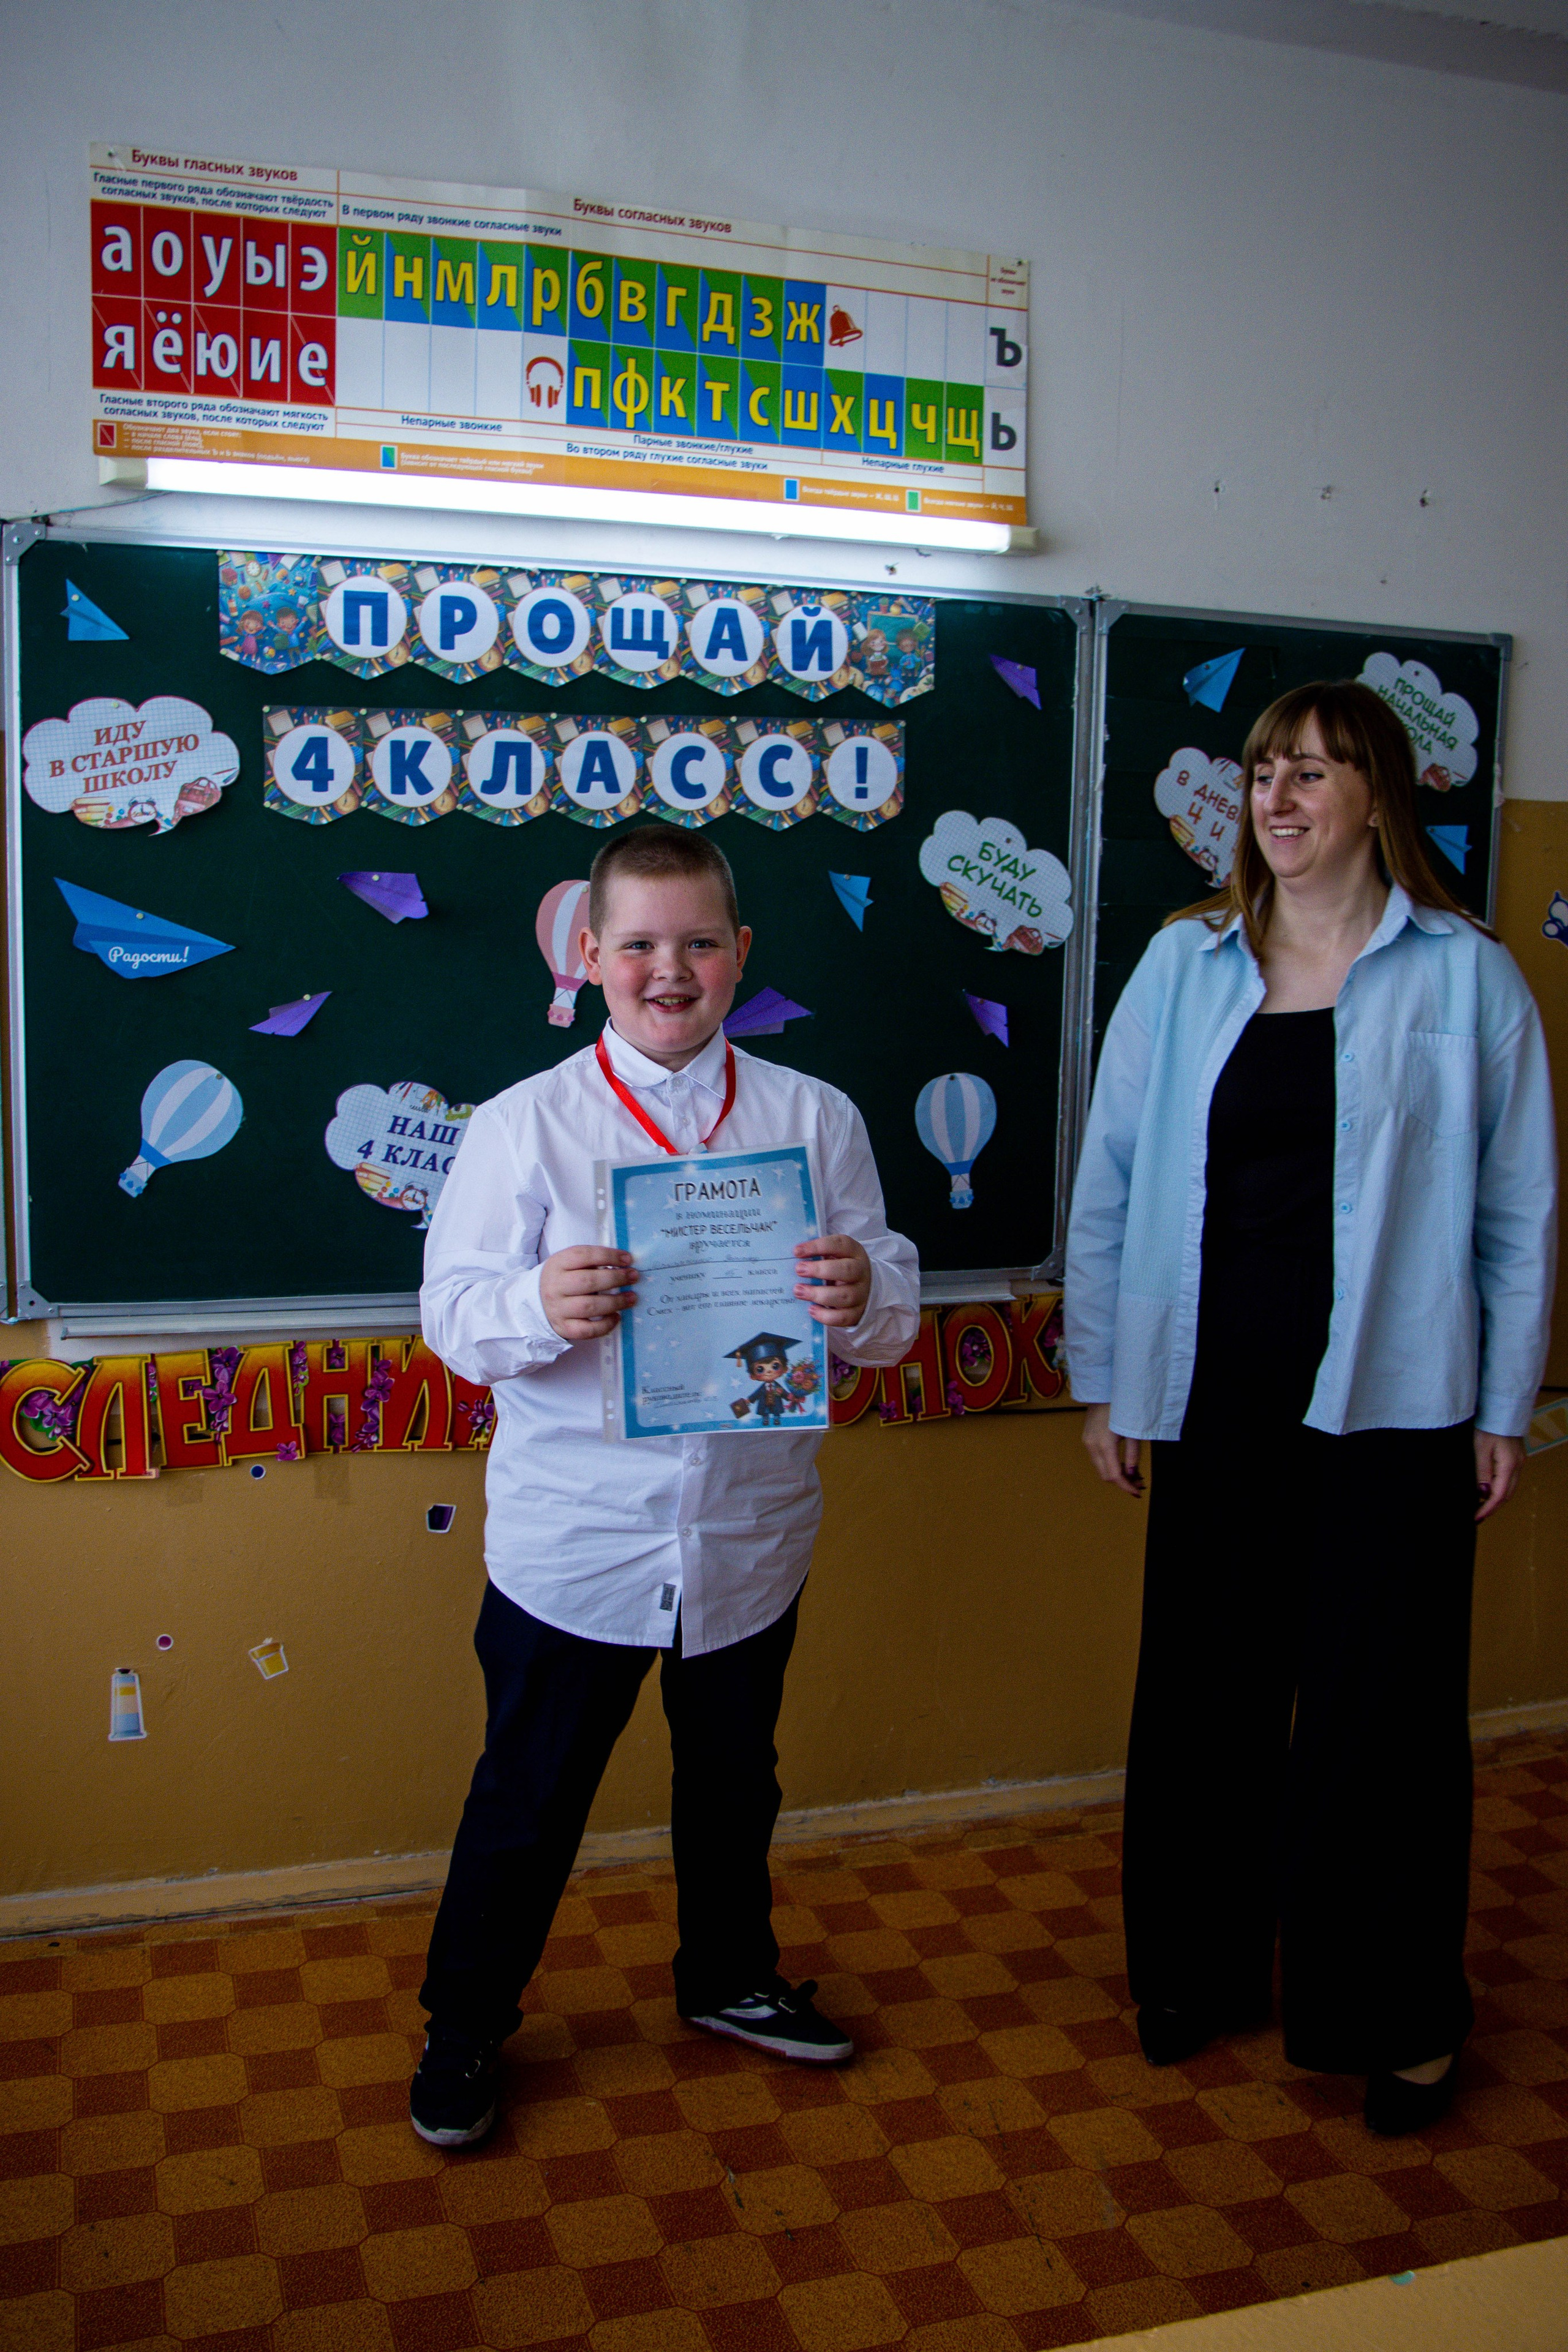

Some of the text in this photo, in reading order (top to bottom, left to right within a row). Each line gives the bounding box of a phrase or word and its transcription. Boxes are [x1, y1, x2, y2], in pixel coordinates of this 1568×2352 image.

[131, 149, 298, 182] Буквы гласных звуков
[92, 172, 334, 209] Гласные первого ряда обозначают твёрдость
[101, 185, 327, 219] согласных звуков, после которых следуют
[342, 204, 563, 237] В первом ряду звонкие согласные звуки
[573, 197, 732, 233] Буквы согласных звуков
[102, 226, 132, 271] а
[246, 241, 286, 287] ы
[103, 325, 134, 369] я
[153, 311, 183, 373] ё
[196, 333, 239, 378] ю
[298, 343, 328, 386] е
[100, 394, 328, 423] Гласные второго ряда обозначают мягкость
[104, 405, 325, 432] согласных звуков, после которых следуют
[401, 415, 503, 432] Непарные звонкие
[567, 443, 767, 472] Во втором ряду глухие согласные звуки
[633, 434, 753, 455] Парные звонкие/глухие
[862, 456, 944, 474] Непарные глухие
[343, 590, 834, 672] ПРОЩАЙ
[1378, 684, 1458, 751] НАЧАЛЬНАЯ
[1394, 677, 1456, 728] ПРОЩАЙ
[94, 720, 146, 746] ИДУ
[1404, 724, 1433, 755] ОЛА
[50, 734, 200, 778] В СТАРШУЮ
[291, 736, 869, 800] 4 КЛАСС!
[83, 760, 178, 794] ШКОЛУ
[1176, 769, 1242, 824] В ДНЕВ
[978, 841, 1037, 881] БУДУ
[947, 855, 1042, 918] СКУЧАТЬ
[108, 946, 190, 969] Радости!
[387, 1115, 461, 1146] НАШ
[357, 1139, 456, 1175] 4 КЛАС
[675, 1177, 762, 1202] ГРАМОТА
[676, 1208, 761, 1221] в номинации
[689, 1239, 751, 1254] вручается
